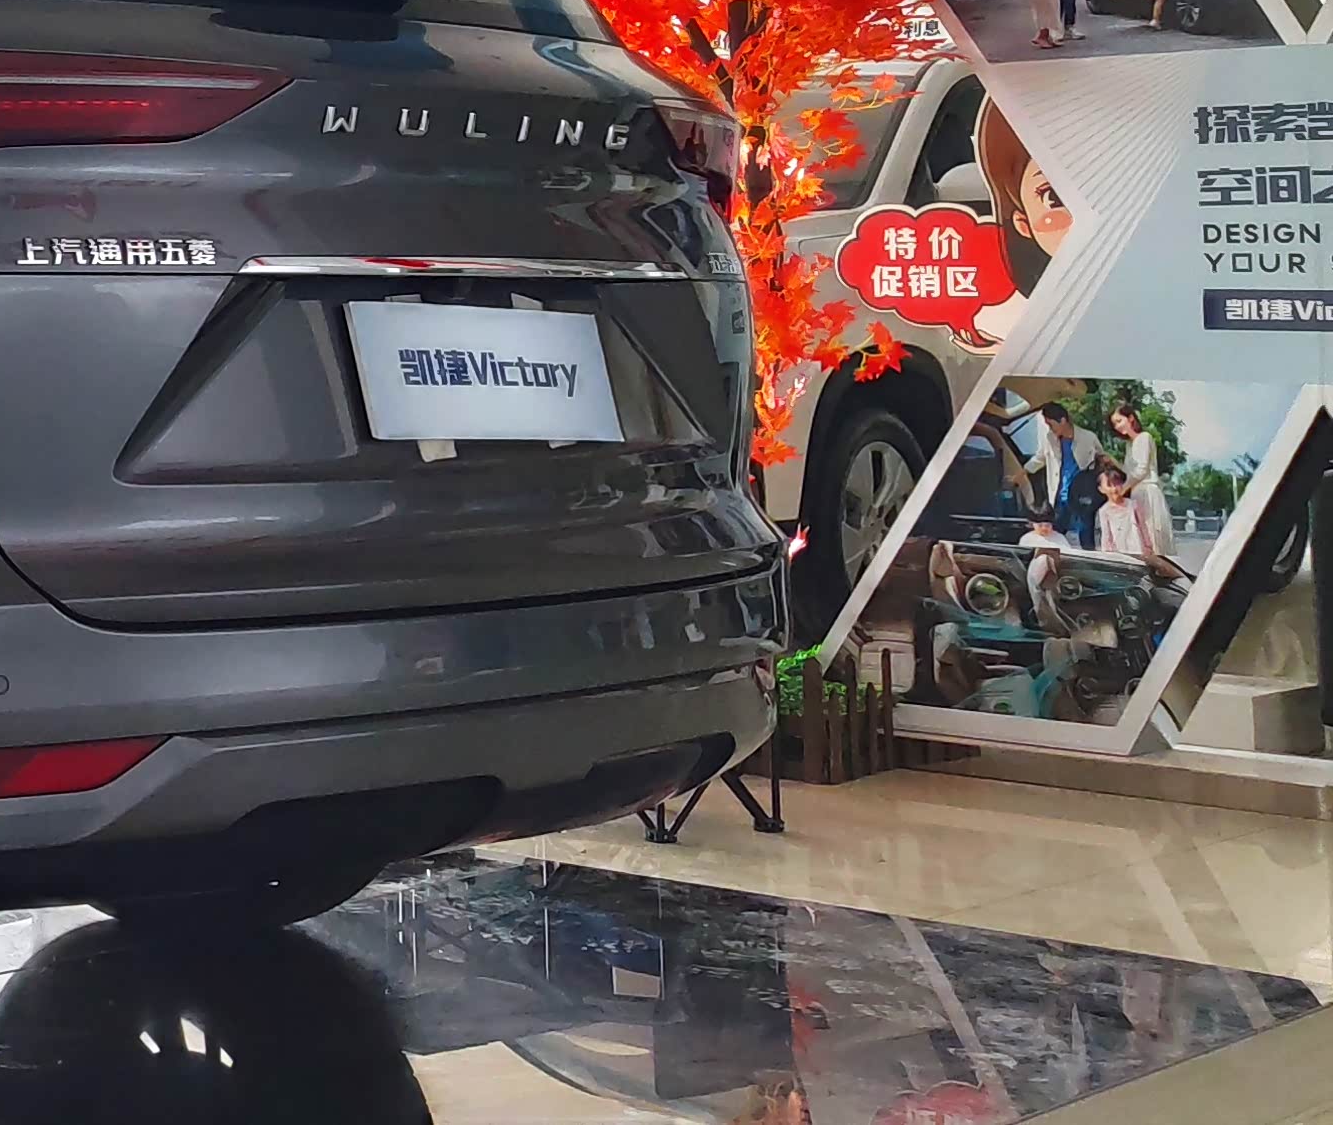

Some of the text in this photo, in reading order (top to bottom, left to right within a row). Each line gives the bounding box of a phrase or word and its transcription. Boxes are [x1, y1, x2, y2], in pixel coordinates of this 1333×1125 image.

[323, 105, 630, 151] WULING
[883, 226, 963, 261] 特价
[1203, 223, 1321, 243] DESIGN
[17, 238, 217, 265] 上汽通用五菱
[1204, 252, 1307, 273] YOUR
[871, 265, 980, 299] 促销区
[398, 348, 578, 397] 凯捷Victory
